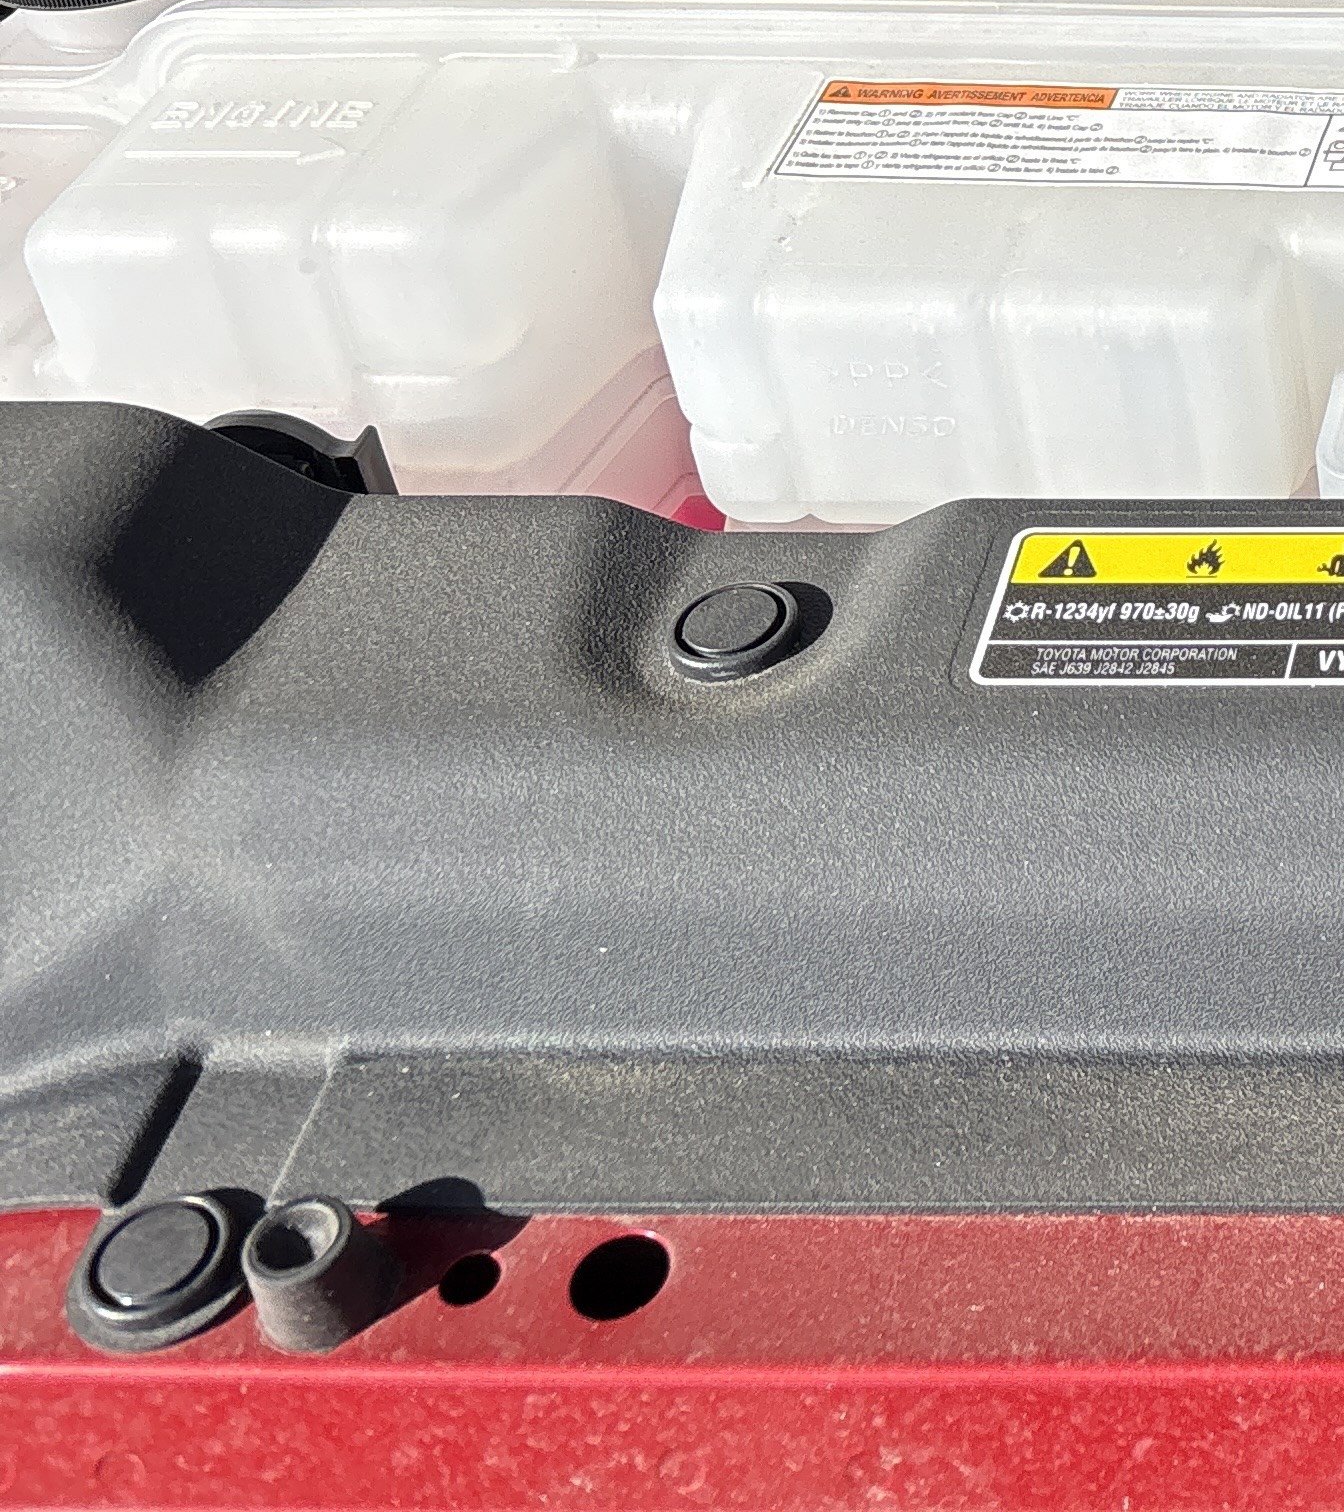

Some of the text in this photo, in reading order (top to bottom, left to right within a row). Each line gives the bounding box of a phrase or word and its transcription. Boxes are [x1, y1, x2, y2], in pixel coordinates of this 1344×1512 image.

[858, 88, 1106, 103] WARNING AVERTISSEMENT ADVERTENCIA
[151, 100, 375, 130] ENGINE
[832, 414, 956, 436] DENSO
[1030, 602, 1115, 622] R-1234yf
[1121, 602, 1200, 623] 970±30g
[1243, 601, 1323, 620] ND-OIL11
[1036, 647, 1238, 661] TOYOTA MOTOR CORPORATION
[1031, 661, 1175, 675] SAE J639 J2842 J2845
